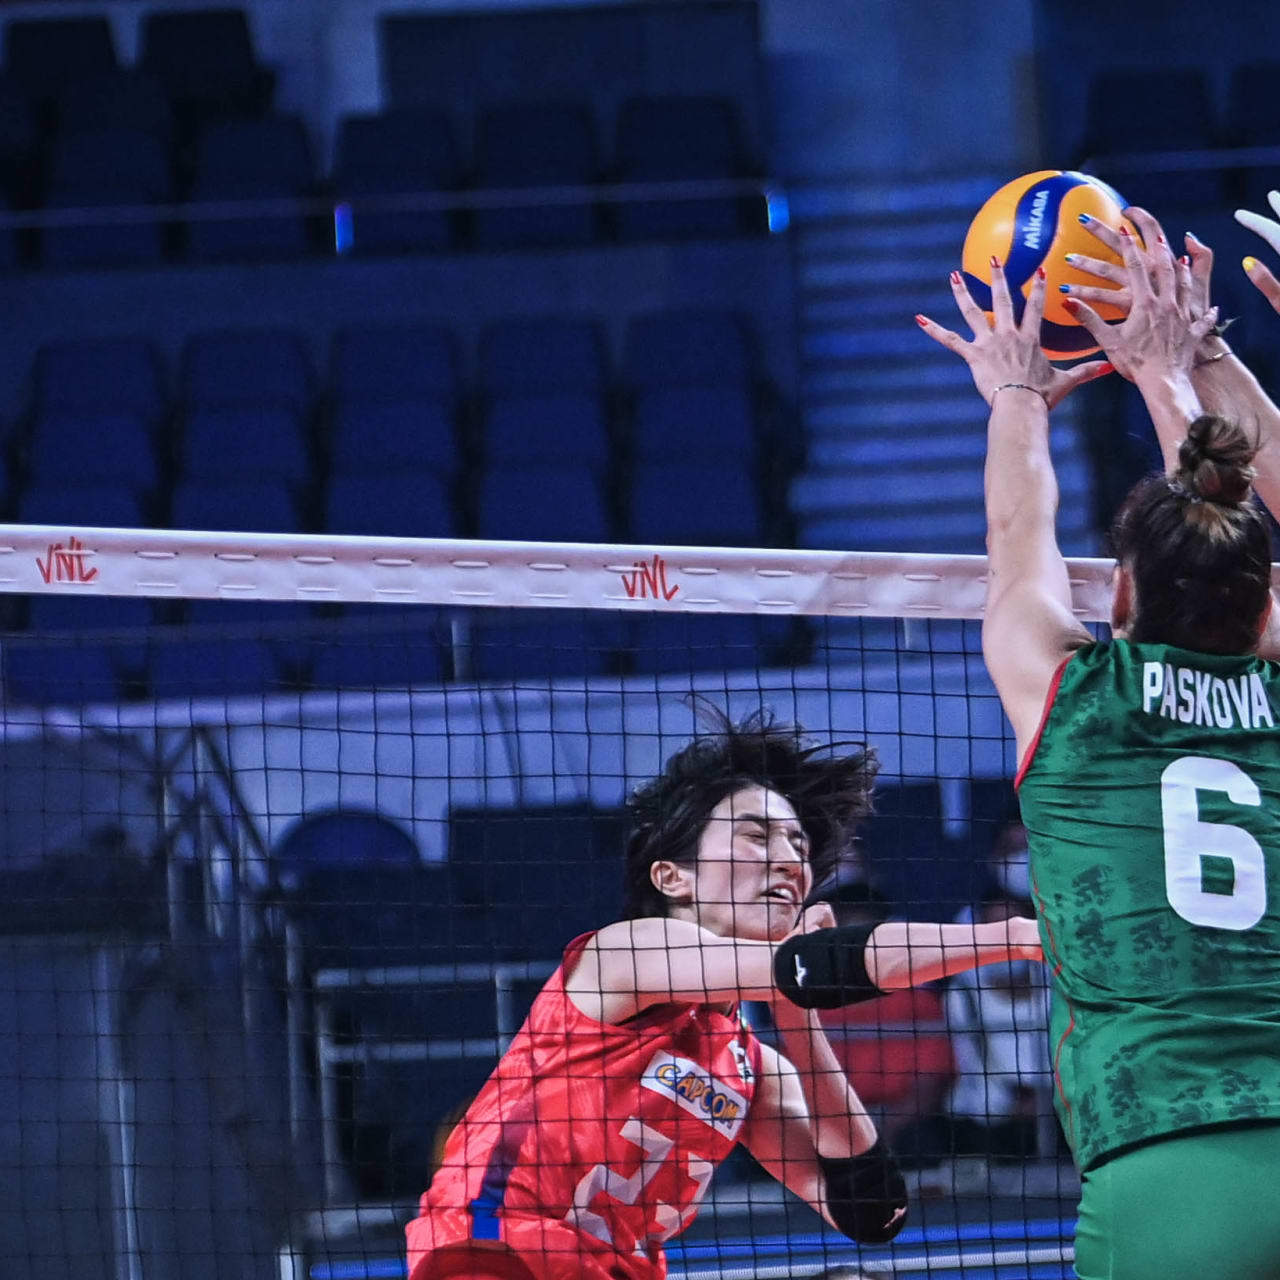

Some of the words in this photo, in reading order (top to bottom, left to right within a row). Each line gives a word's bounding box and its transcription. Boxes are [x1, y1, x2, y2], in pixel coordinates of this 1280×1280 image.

[35, 536, 98, 584] VNL
[621, 554, 681, 601] VNL
[1143, 661, 1274, 730] PASKOVA
[1161, 756, 1267, 931] 6
[654, 1062, 741, 1131] CAPCOM
